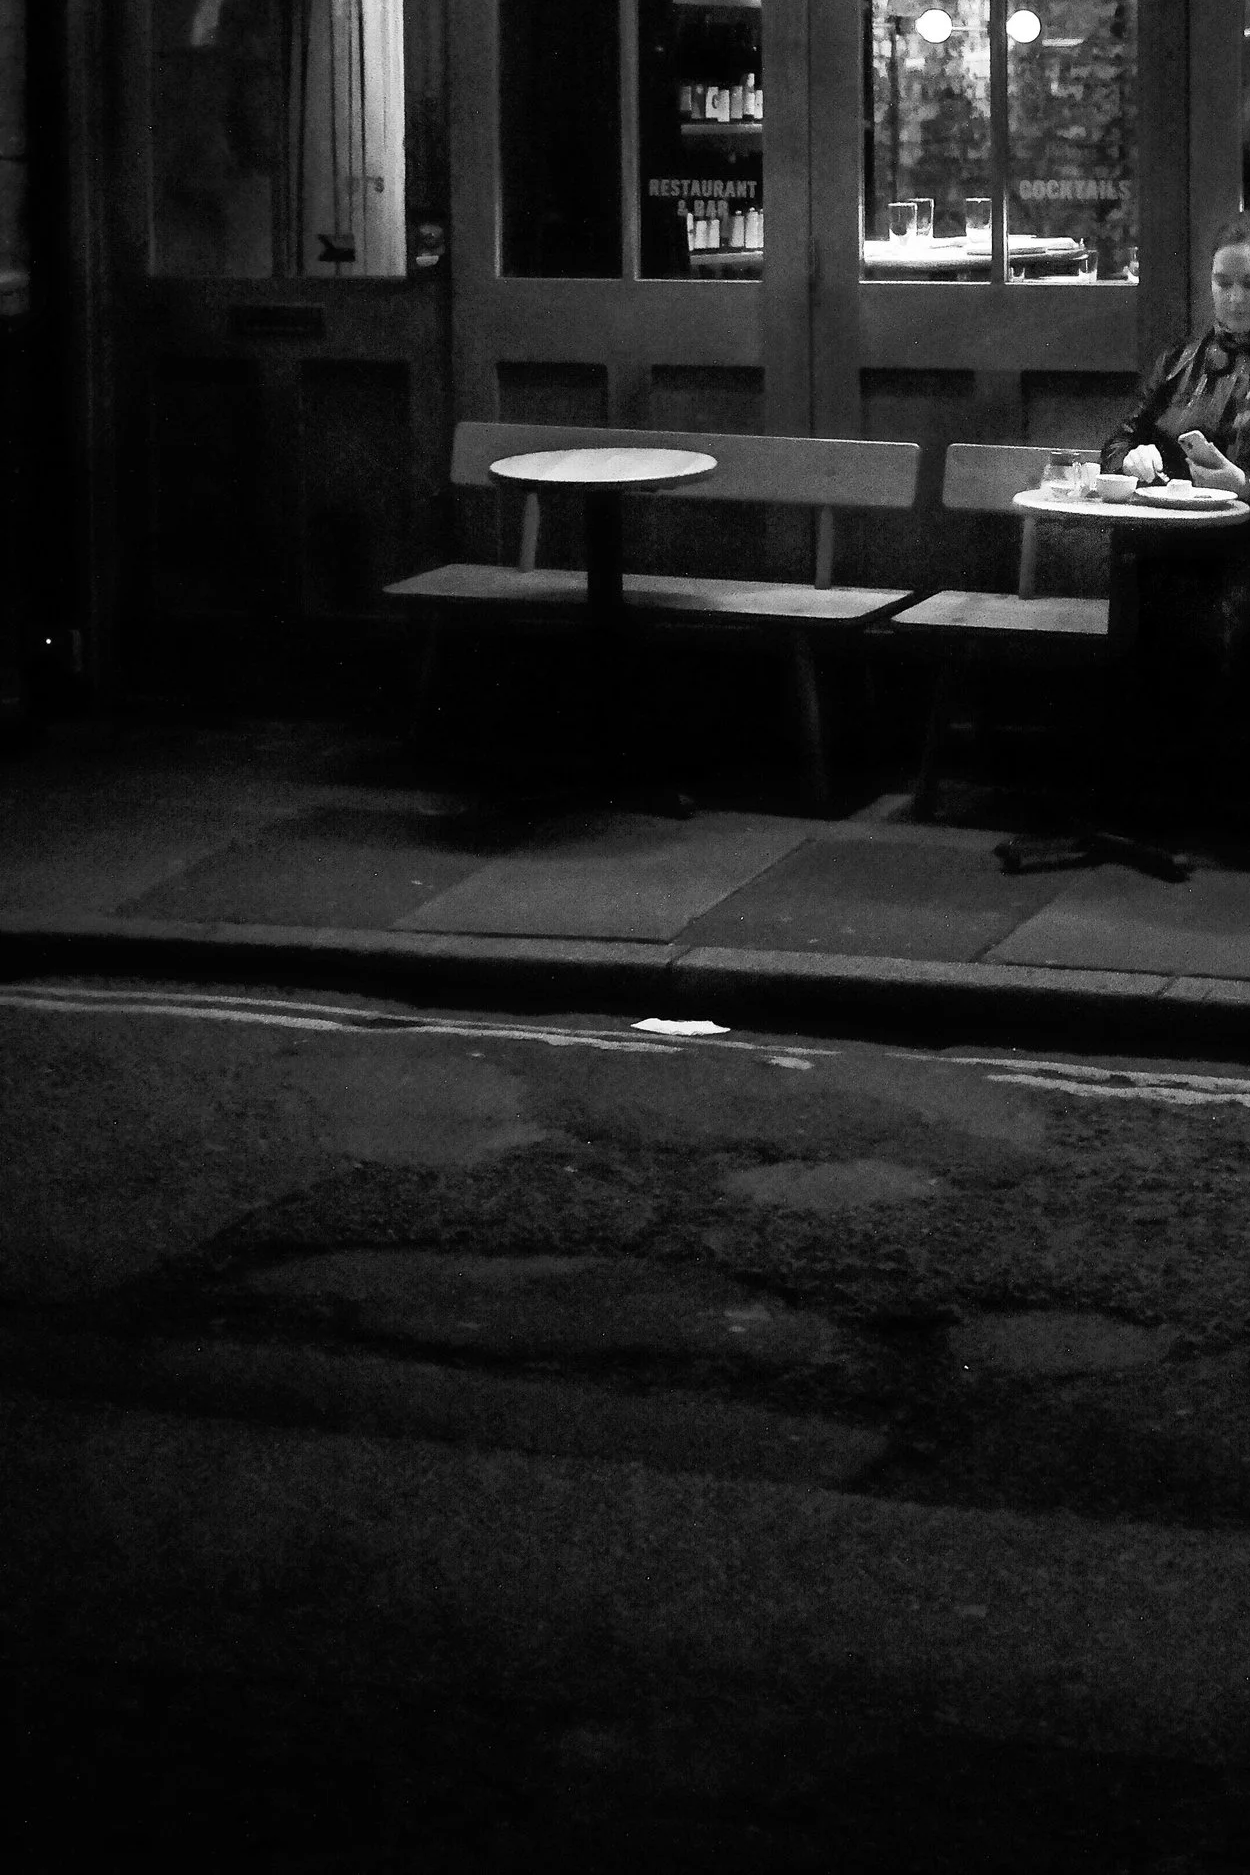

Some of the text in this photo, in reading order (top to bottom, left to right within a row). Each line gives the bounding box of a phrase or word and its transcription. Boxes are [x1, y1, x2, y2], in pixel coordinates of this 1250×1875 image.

[649, 178, 757, 198] RESTAURANT
[1019, 180, 1132, 200] COCKTAILS
[677, 199, 728, 217] & BAR
